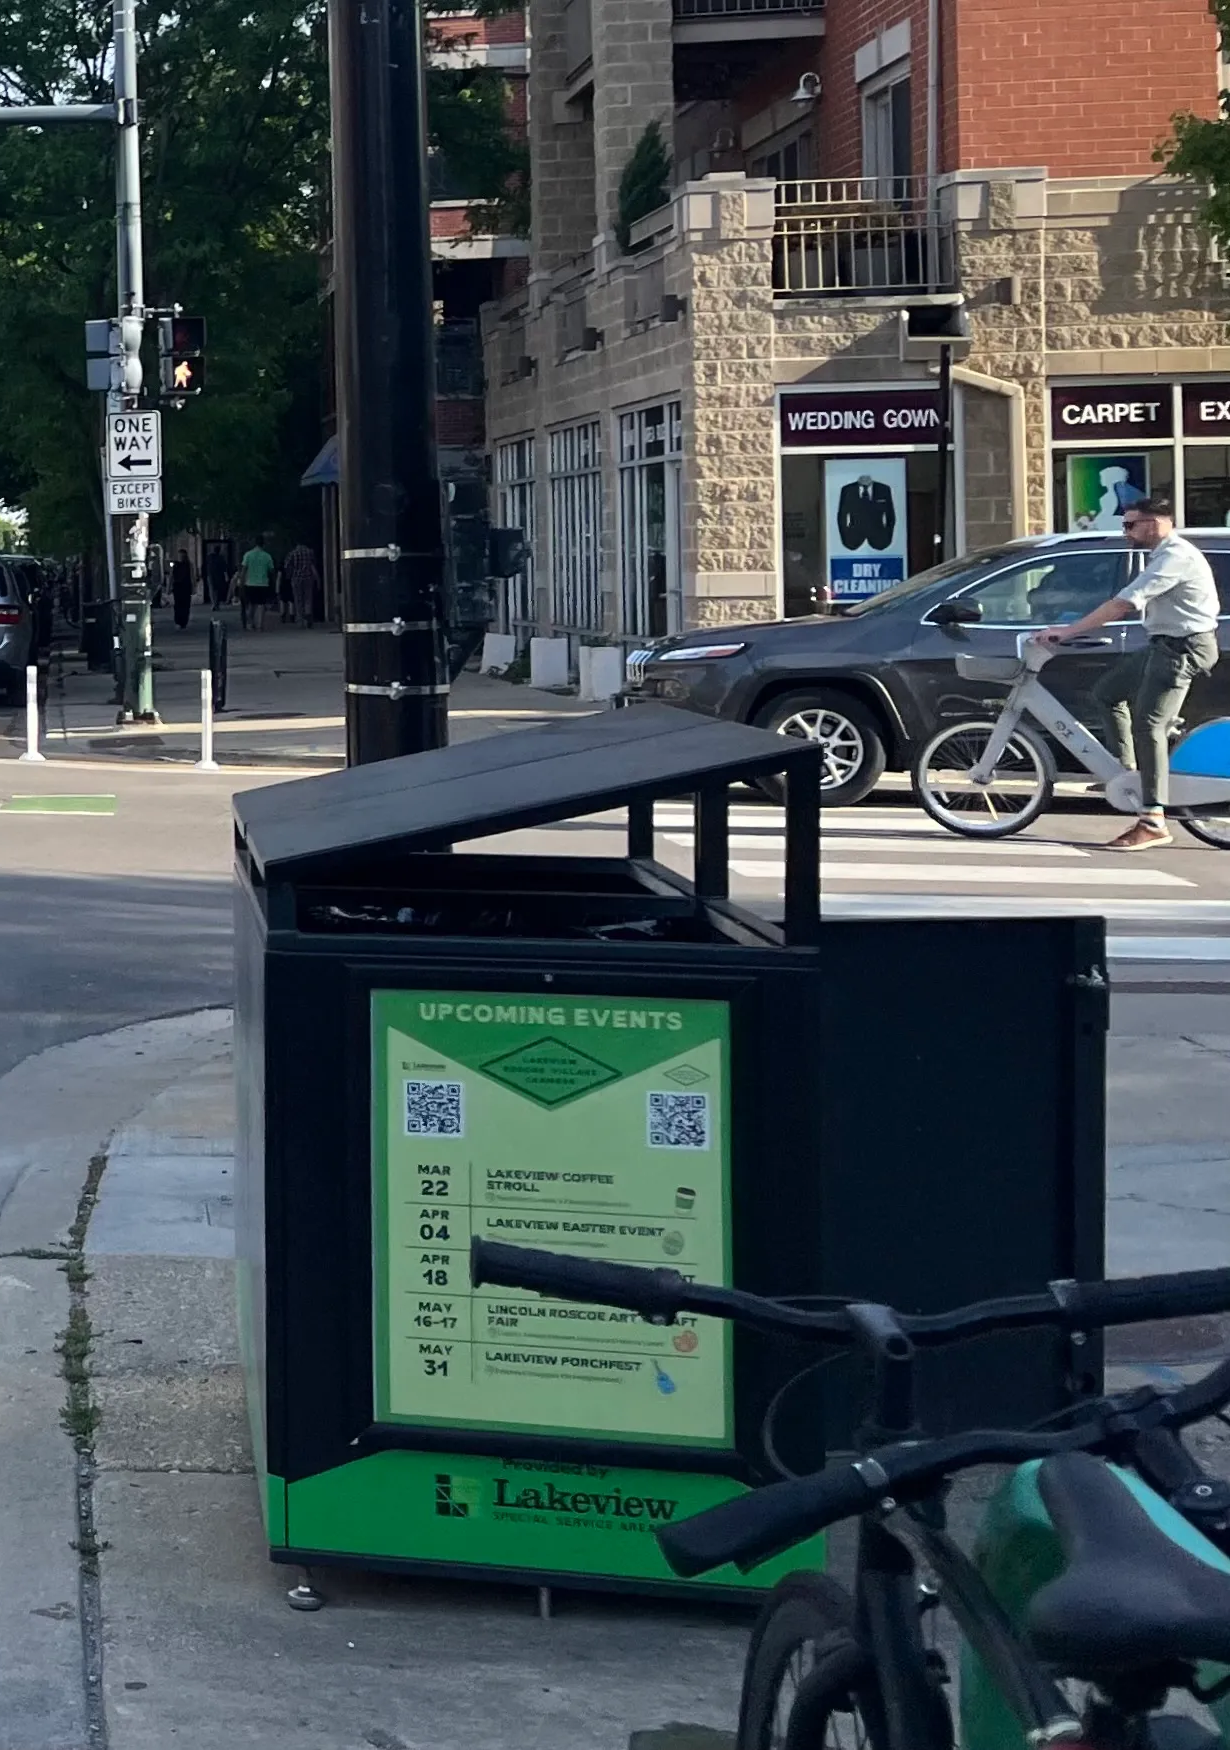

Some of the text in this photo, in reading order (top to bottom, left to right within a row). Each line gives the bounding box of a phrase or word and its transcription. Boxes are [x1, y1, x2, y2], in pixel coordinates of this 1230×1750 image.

[787, 409, 875, 431] WEDDING
[1062, 402, 1161, 425] CARPET
[114, 417, 152, 433] ONE
[114, 435, 153, 451] WAY
[112, 482, 156, 495] EXCEPT
[117, 497, 152, 509] BIKES
[852, 563, 882, 578] DRY
[419, 1003, 684, 1030] UPCOMING EVENTS
[417, 1164, 451, 1176] MAR
[486, 1168, 615, 1185] LAKEVIEW COFFEE
[421, 1179, 449, 1196] 22
[486, 1180, 540, 1192] STROLL
[419, 1209, 450, 1220] APR
[419, 1224, 450, 1241] 04
[486, 1217, 665, 1237] LAKEVIEW EASTER EVENT
[419, 1254, 450, 1265] APR
[422, 1269, 448, 1286] 18
[418, 1302, 452, 1313] MAY
[487, 1304, 546, 1317] LINCOLN
[549, 1307, 606, 1321] ROSCOE
[608, 1311, 637, 1323] ART
[487, 1317, 519, 1328] FAIR
[418, 1343, 453, 1356] MAY
[423, 1359, 449, 1377] 31
[485, 1351, 643, 1371] LAKEVIEW PORCHFEST
[492, 1478, 680, 1520] Lakeview
[555, 1516, 613, 1530] SERVICE
